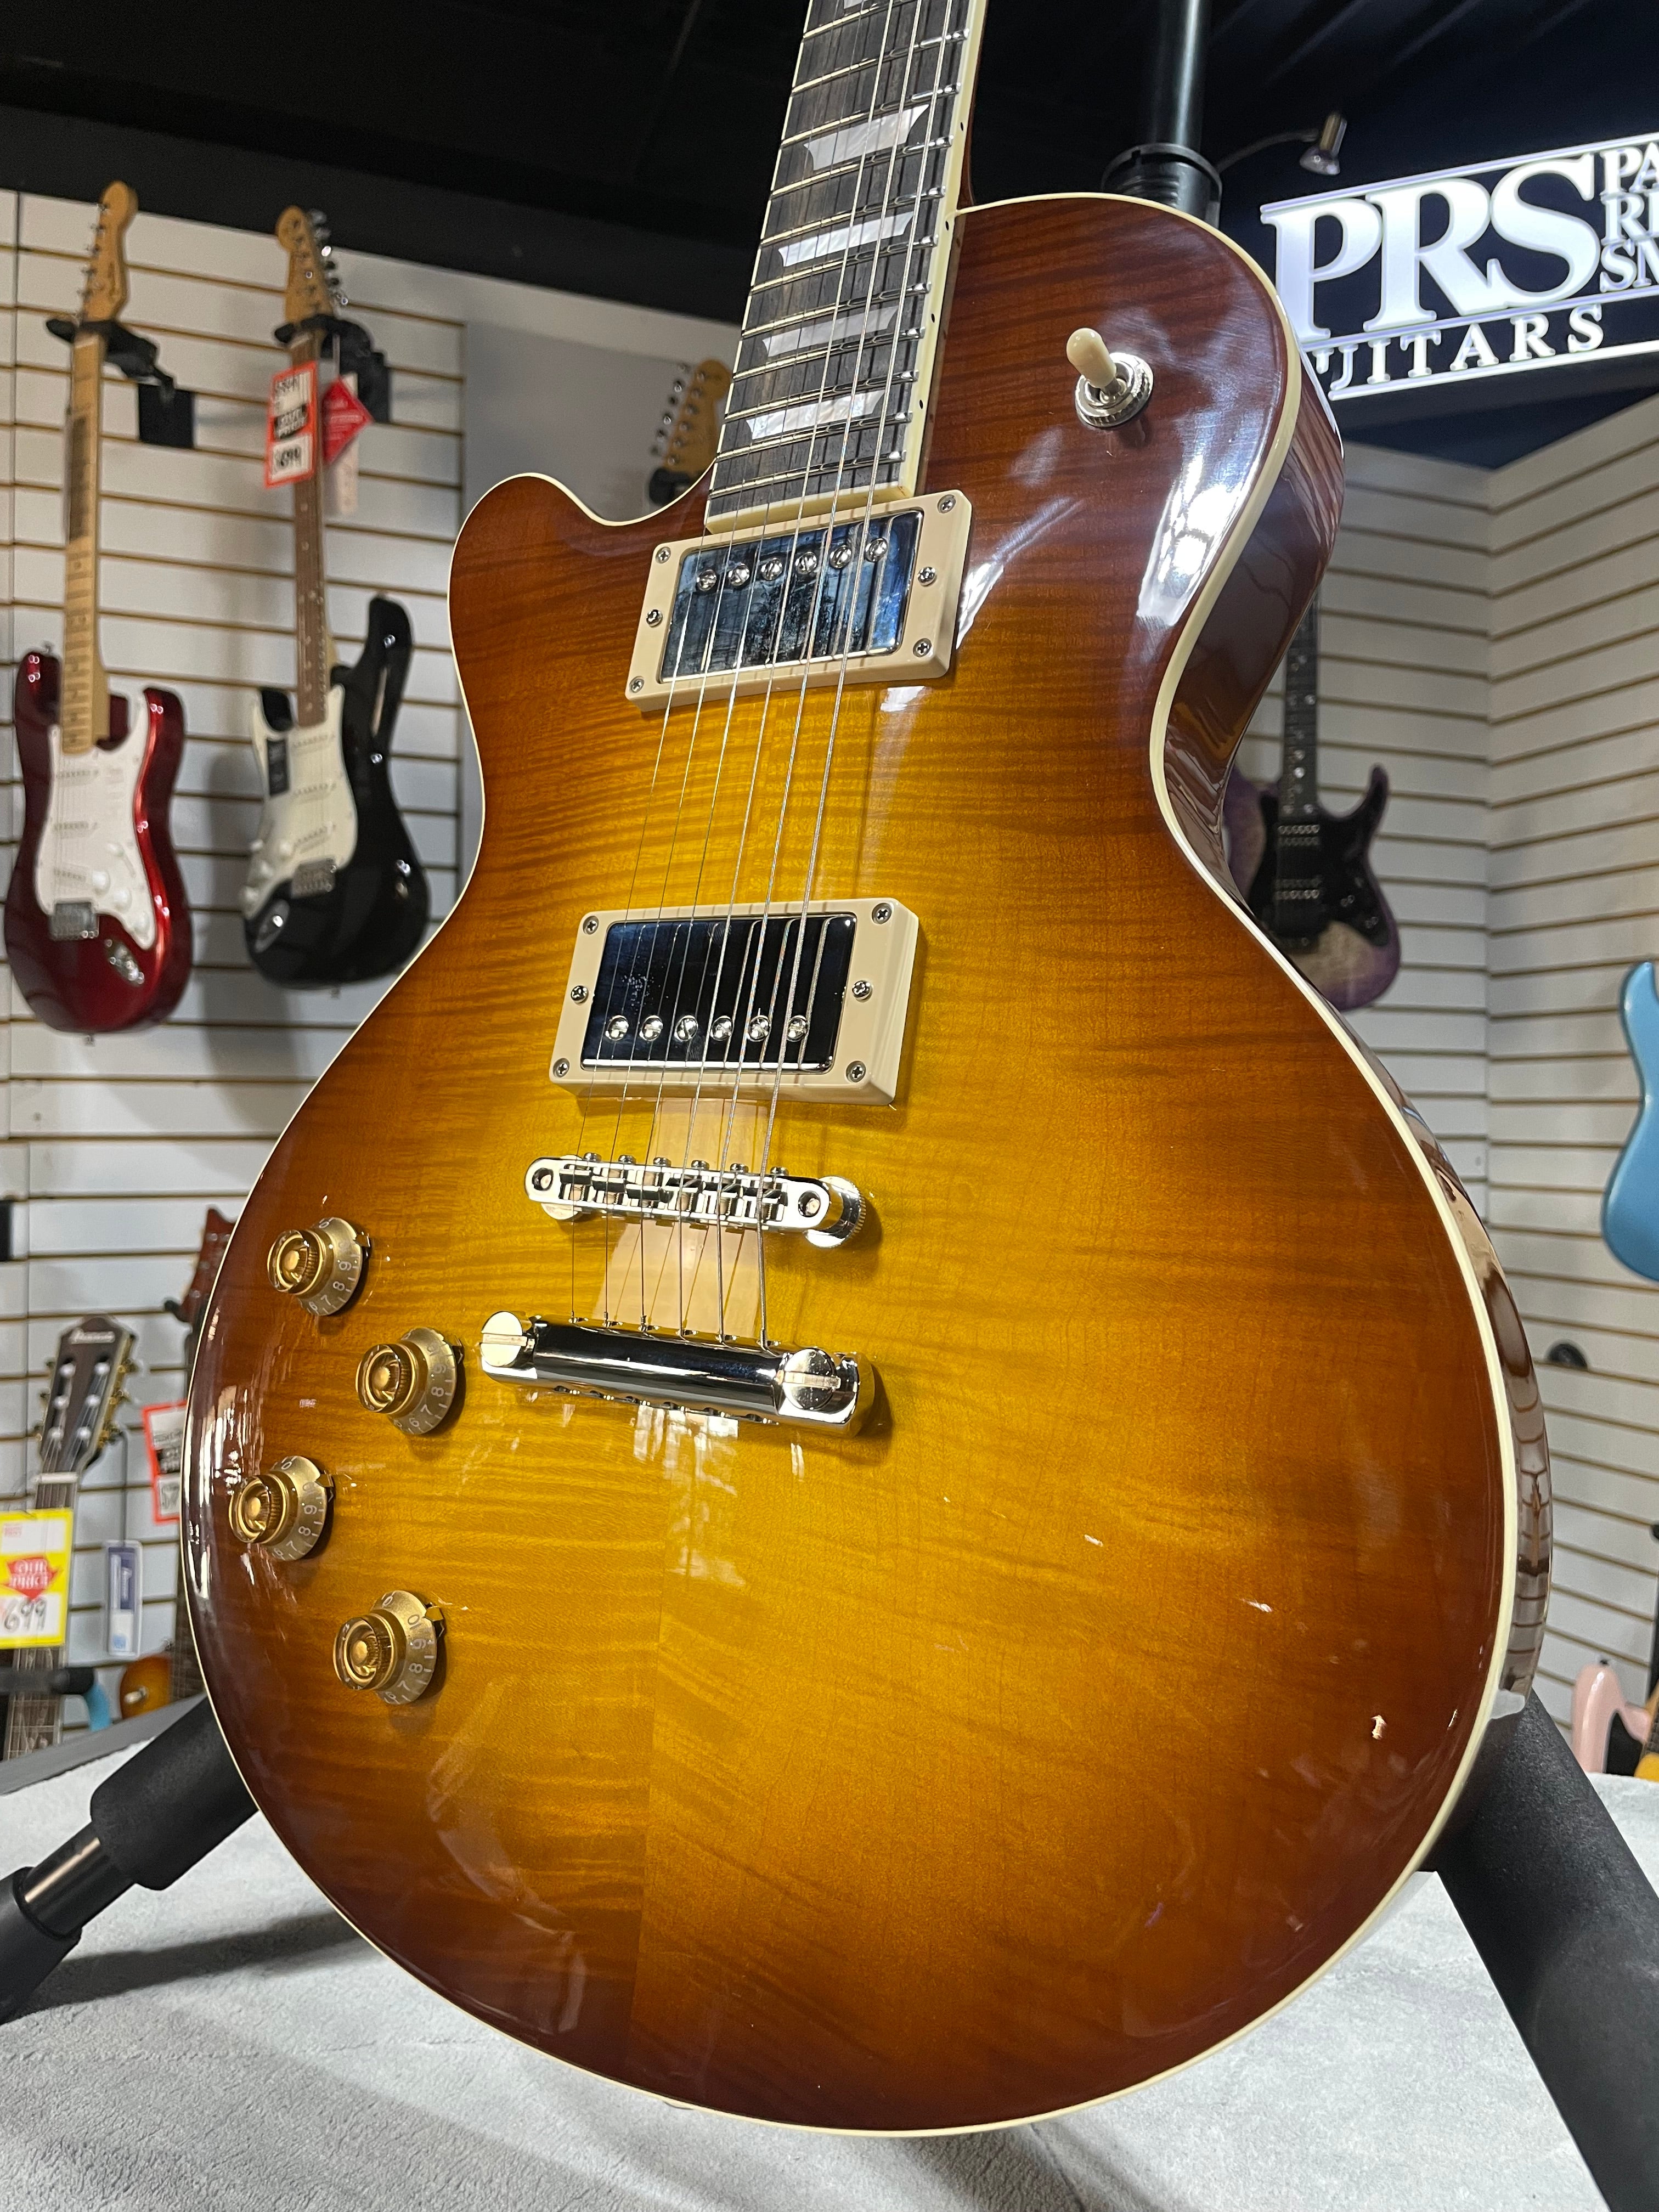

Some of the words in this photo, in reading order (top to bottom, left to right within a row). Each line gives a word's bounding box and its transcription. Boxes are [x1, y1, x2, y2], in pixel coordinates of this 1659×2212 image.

[1260, 151, 1600, 342] PRS
[1312, 304, 1605, 391] UITARS
[338, 1261, 352, 1271] 9
[332, 1281, 345, 1291] 8
[320, 1295, 331, 1306] 7
[431, 1386, 444, 1397] 8
[420, 1404, 433, 1416] 7
[409, 1417, 420, 1427] 6
[303, 1505, 317, 1515] 9
[298, 1526, 311, 1536] 8
[286, 1541, 298, 1552] 7
[407, 1614, 422, 1629] 10
[412, 1638, 426, 1649] 9
[408, 1663, 423, 1673] 8
[397, 1680, 411, 1691] 7
